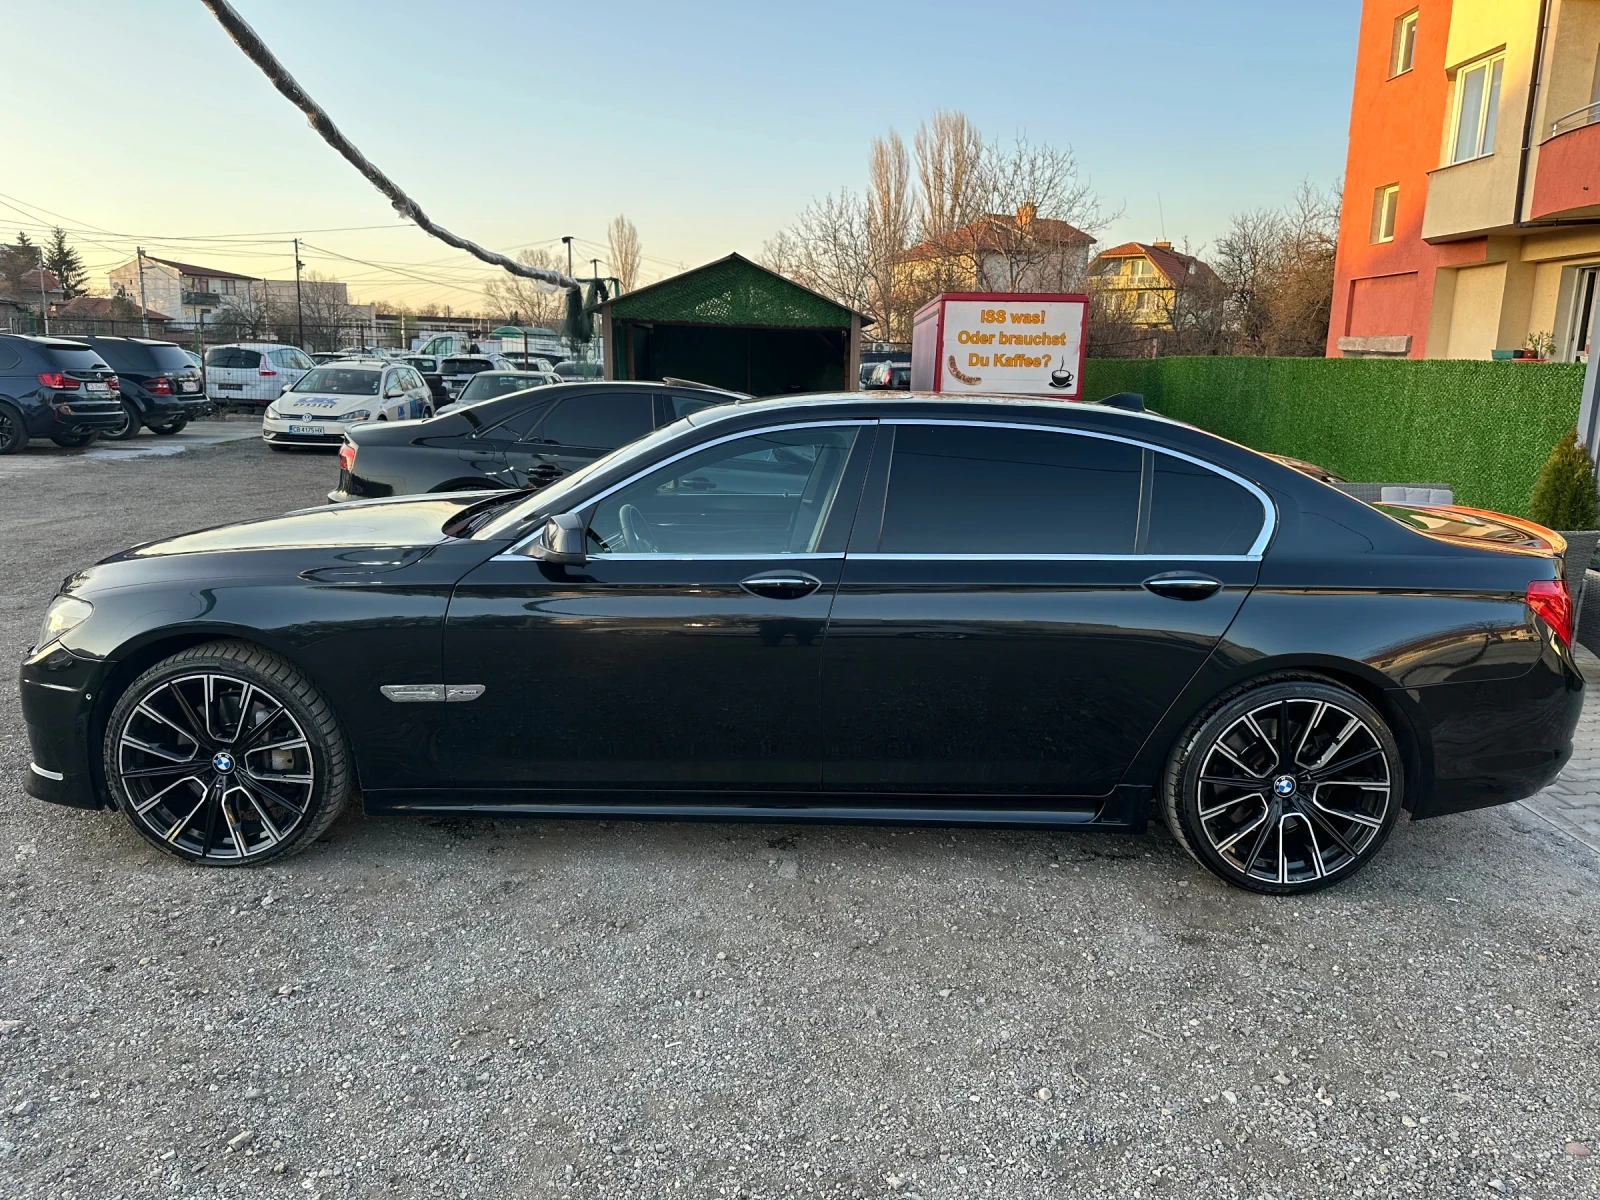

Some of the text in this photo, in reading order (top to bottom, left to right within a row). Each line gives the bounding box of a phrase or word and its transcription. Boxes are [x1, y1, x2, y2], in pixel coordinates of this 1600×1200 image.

[980, 309, 1046, 324] ISS was!
[957, 330, 1066, 346] Oder brauchst
[968, 353, 1052, 368] Du Kaffee?
